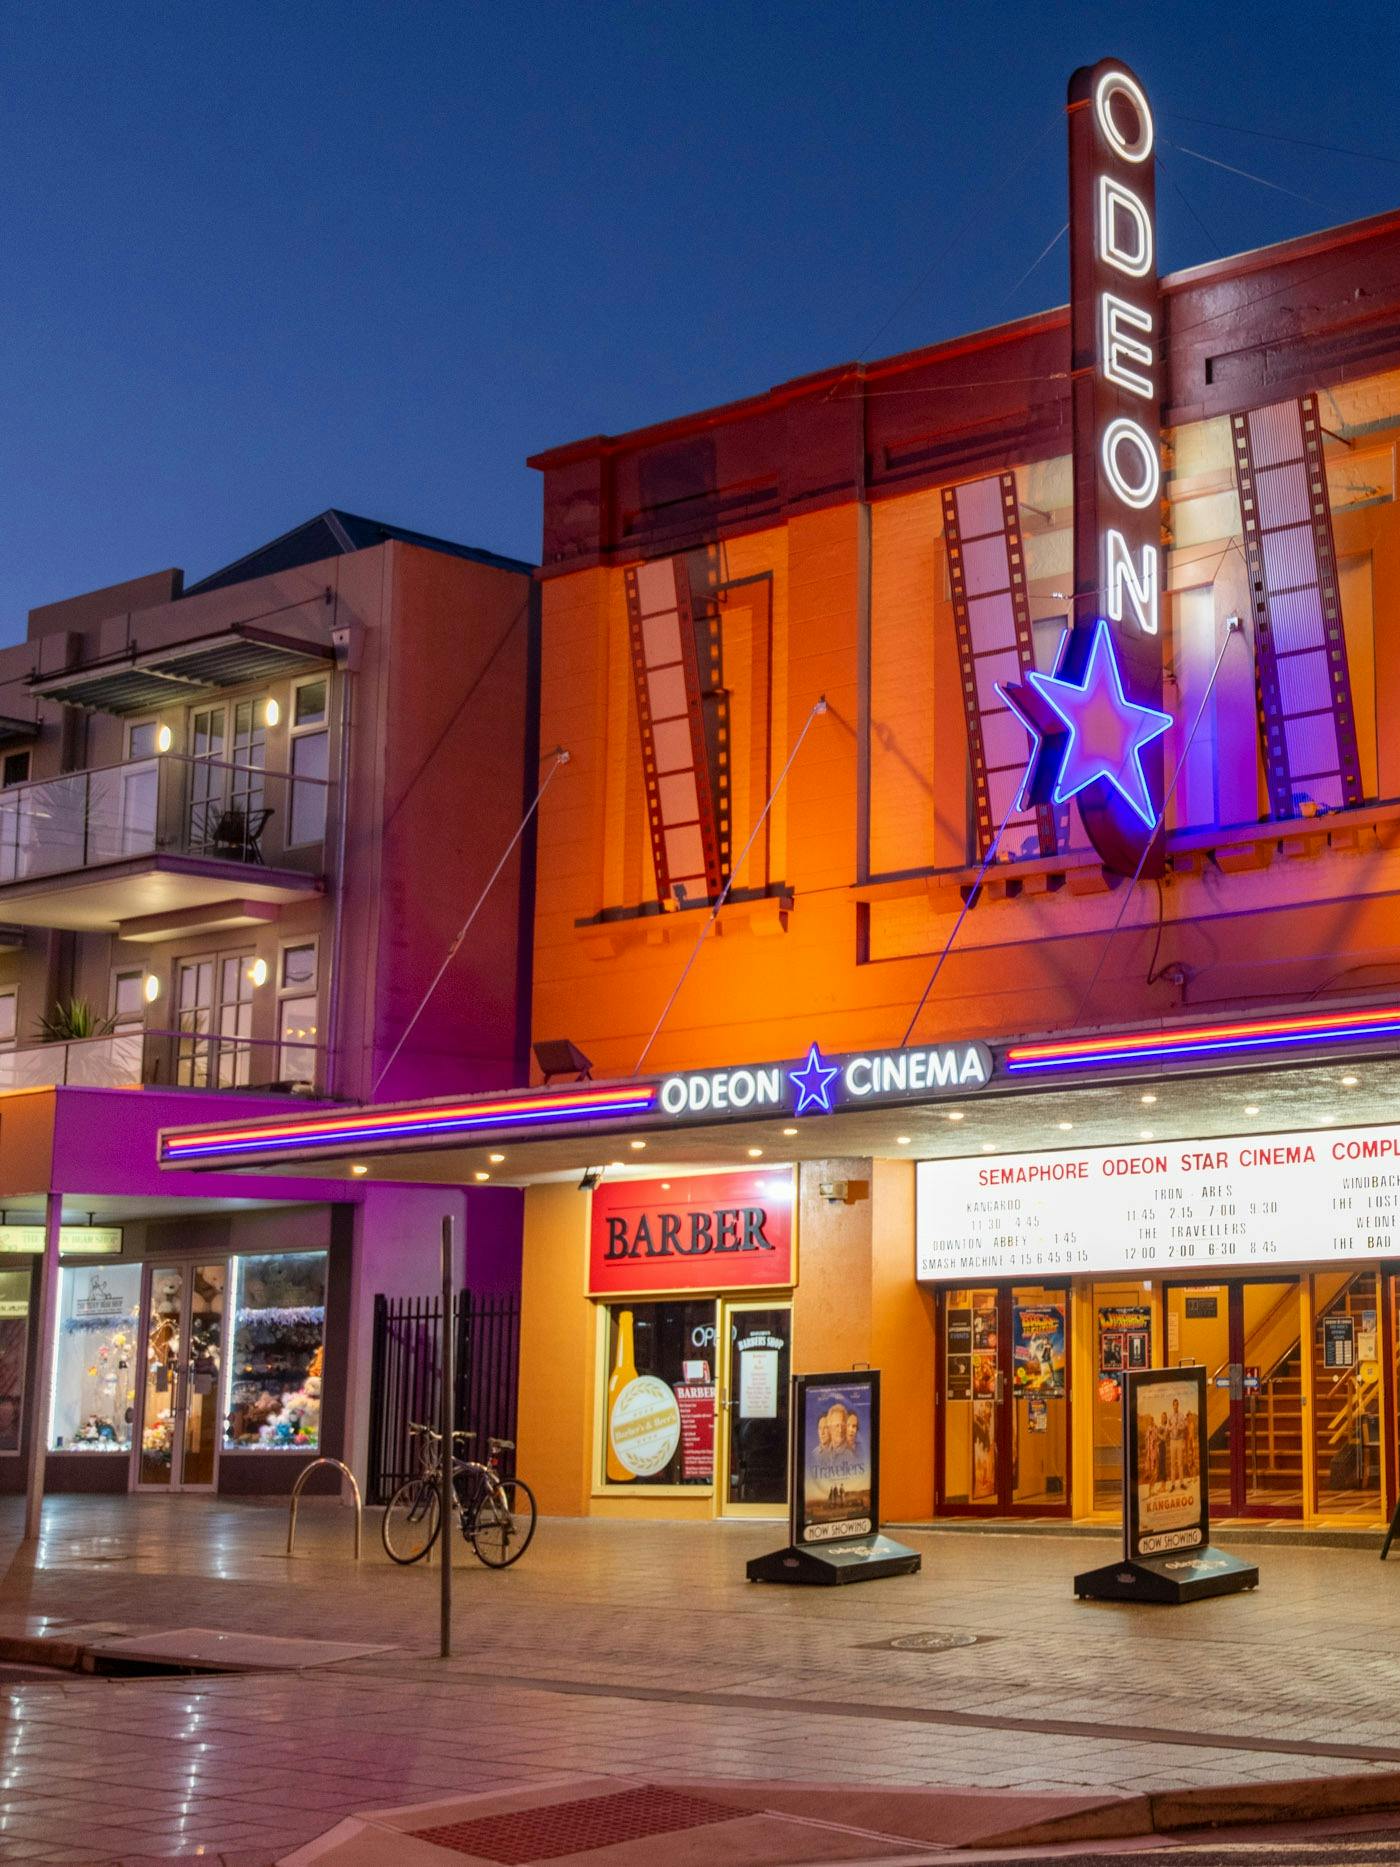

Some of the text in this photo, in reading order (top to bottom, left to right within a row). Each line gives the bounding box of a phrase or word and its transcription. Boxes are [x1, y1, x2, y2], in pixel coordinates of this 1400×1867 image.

[1096, 70, 1159, 635] ODEON
[662, 1047, 985, 1114] ODEON CINEMA
[978, 1161, 1090, 1187] SEMAPHORE
[1102, 1156, 1168, 1177] ODEON
[1181, 1151, 1229, 1172] STAR
[1239, 1145, 1316, 1168] CINEMA
[1155, 1184, 1232, 1201] TRON ARES
[966, 1199, 1021, 1213] KANGAROO
[1332, 1197, 1352, 1210] THE
[1368, 1195, 1399, 1208] LOST
[604, 1206, 776, 1261] BARBER
[1139, 1222, 1247, 1240] THE TRAVELLERS
[933, 1238, 982, 1252] DOWNTON
[993, 1235, 1027, 1248] ABBEY
[1333, 1237, 1353, 1250] THE
[1367, 1235, 1391, 1249] BAD
[922, 1257, 956, 1271] SMASH
[960, 1255, 1003, 1269] MACHINE
[812, 1461, 865, 1480] Travellers
[1146, 1495, 1194, 1513] KANGAROO
[809, 1520, 867, 1539] NOW SHOWING
[1143, 1530, 1198, 1551] NOW SHOWING
